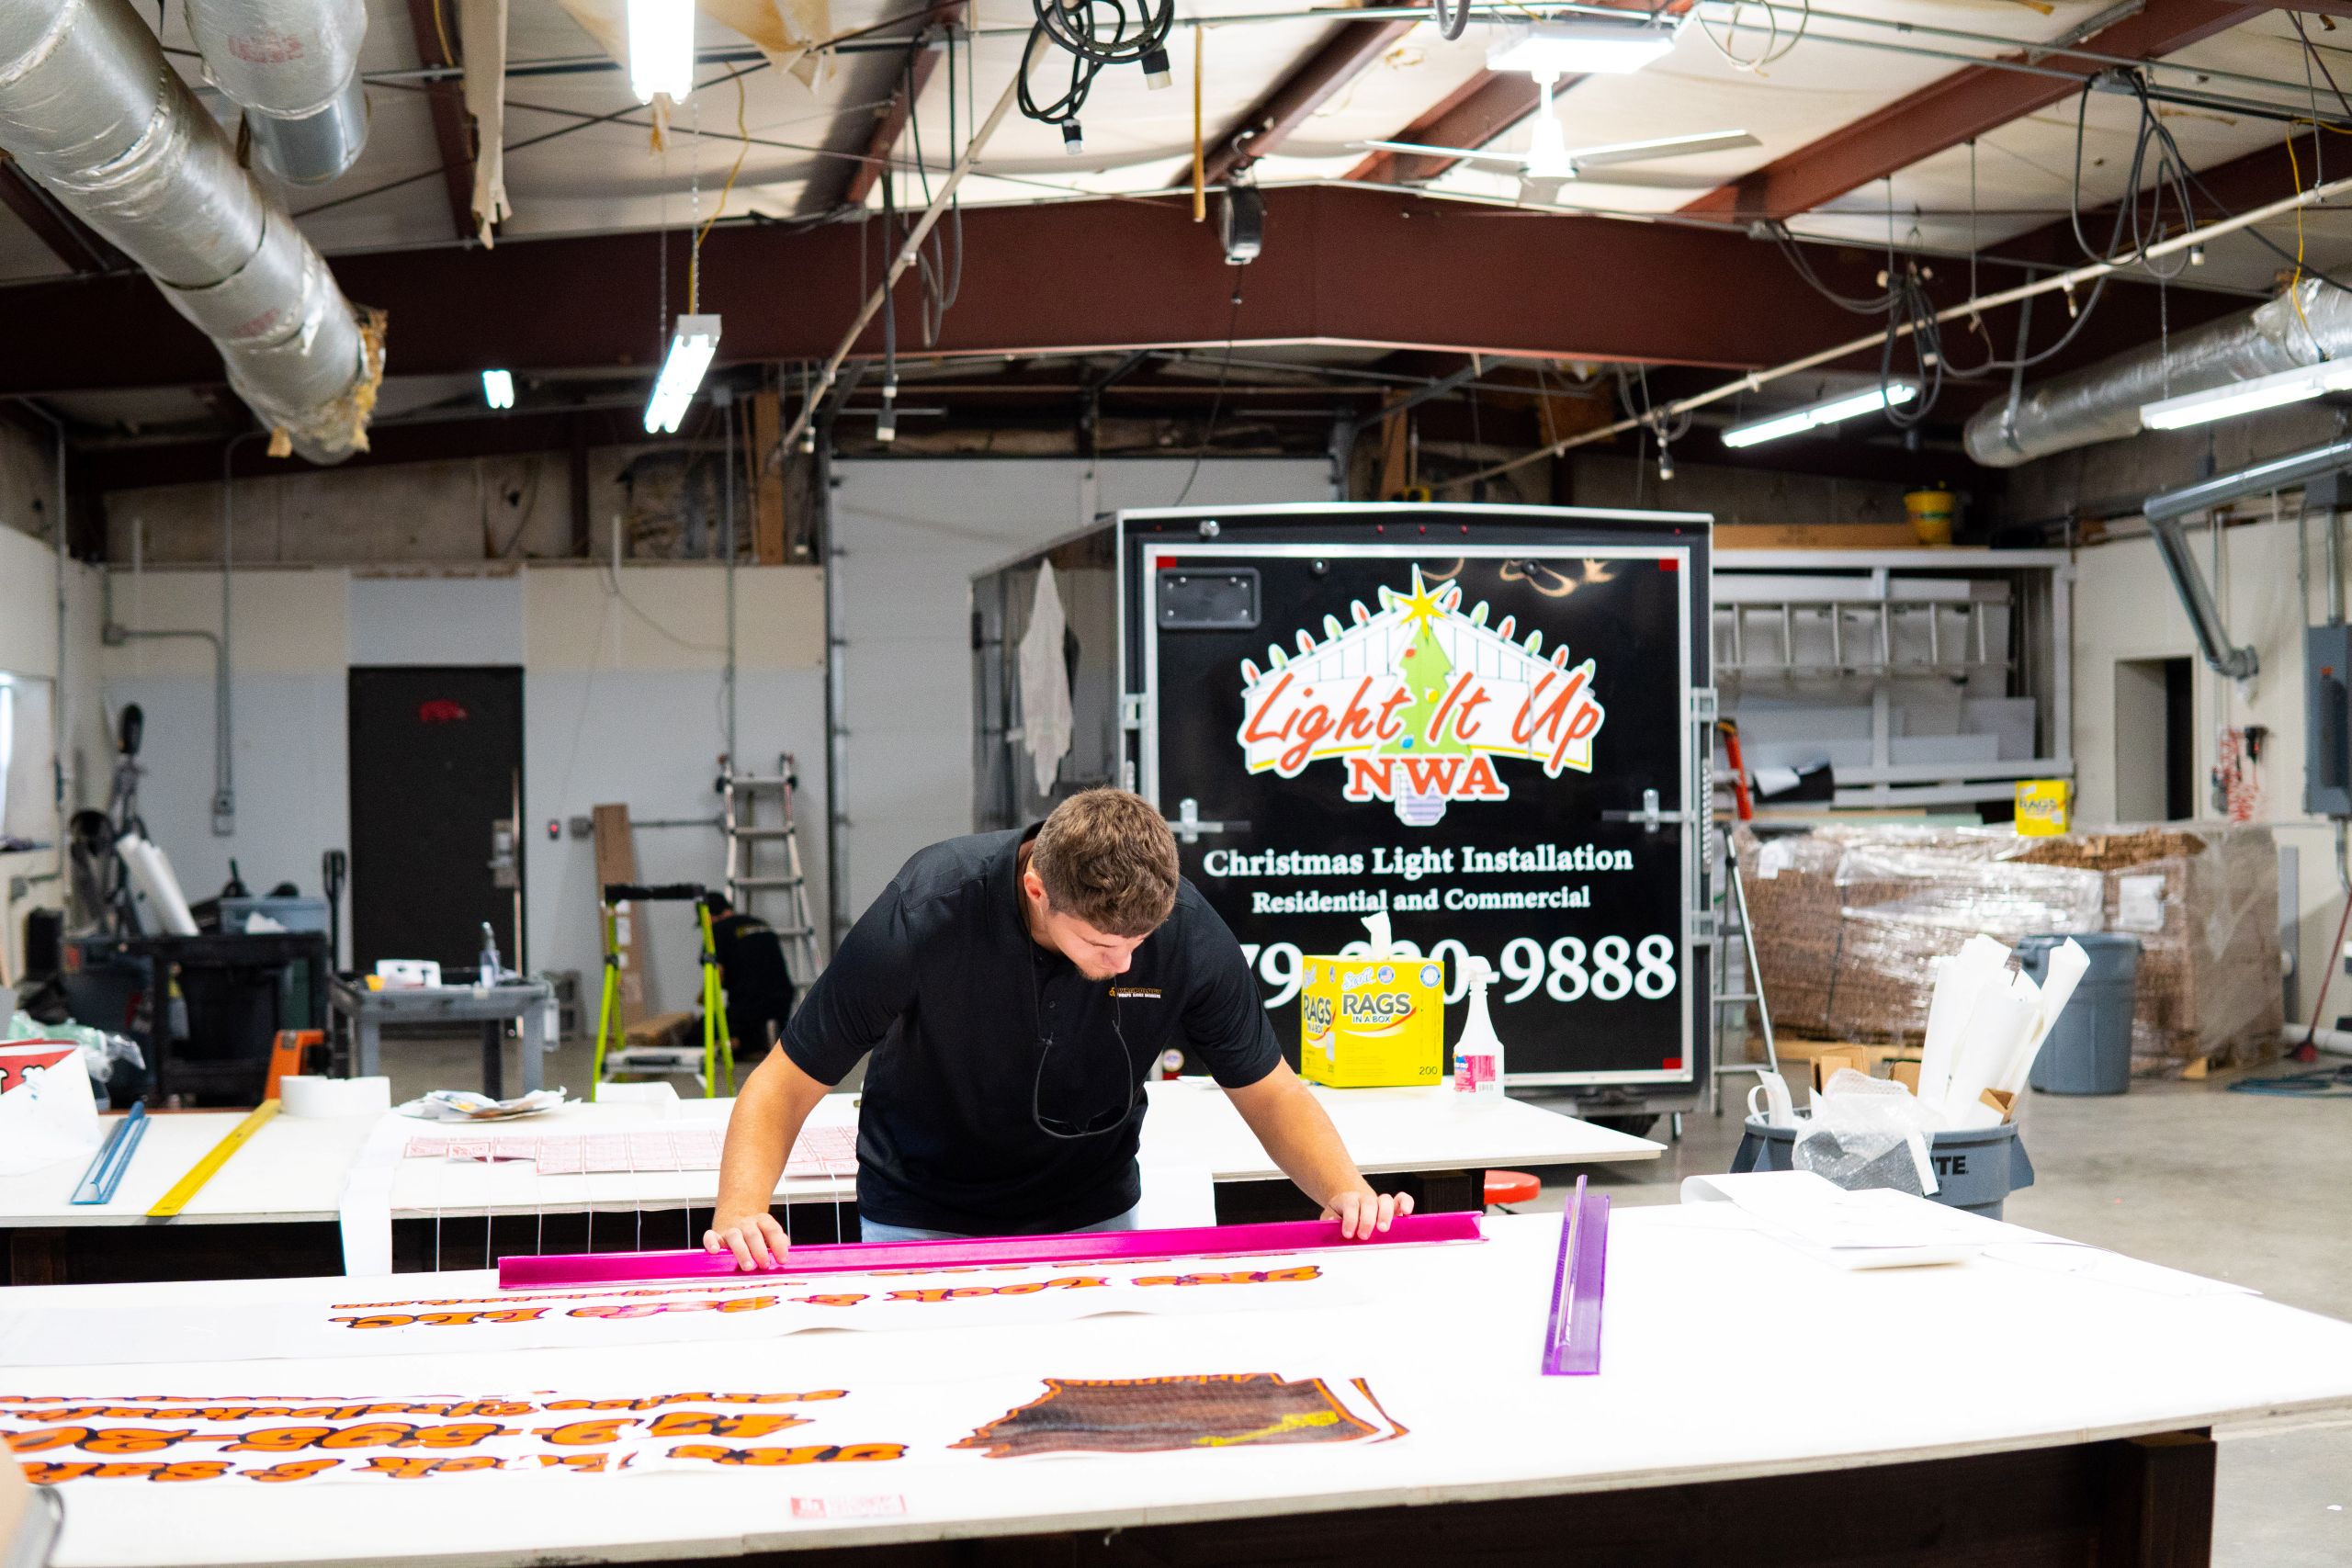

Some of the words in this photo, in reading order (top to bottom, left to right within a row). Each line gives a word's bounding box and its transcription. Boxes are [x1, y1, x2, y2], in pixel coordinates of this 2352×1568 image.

[1244, 671, 1412, 772] Light
[1428, 671, 1491, 742] It
[1511, 671, 1600, 772] Up
[1350, 757, 1504, 796] NWA
[1203, 849, 1364, 876] Christmas
[1371, 846, 1454, 881] Light
[1461, 843, 1634, 874] Installation
[1251, 888, 1387, 914] Residential
[1393, 888, 1439, 911] and
[1443, 886, 1591, 910] Commercial
[1303, 994, 1332, 1026] RAGS
[1342, 993, 1410, 1015] RAGS
[1419, 1066, 1438, 1075] 200
